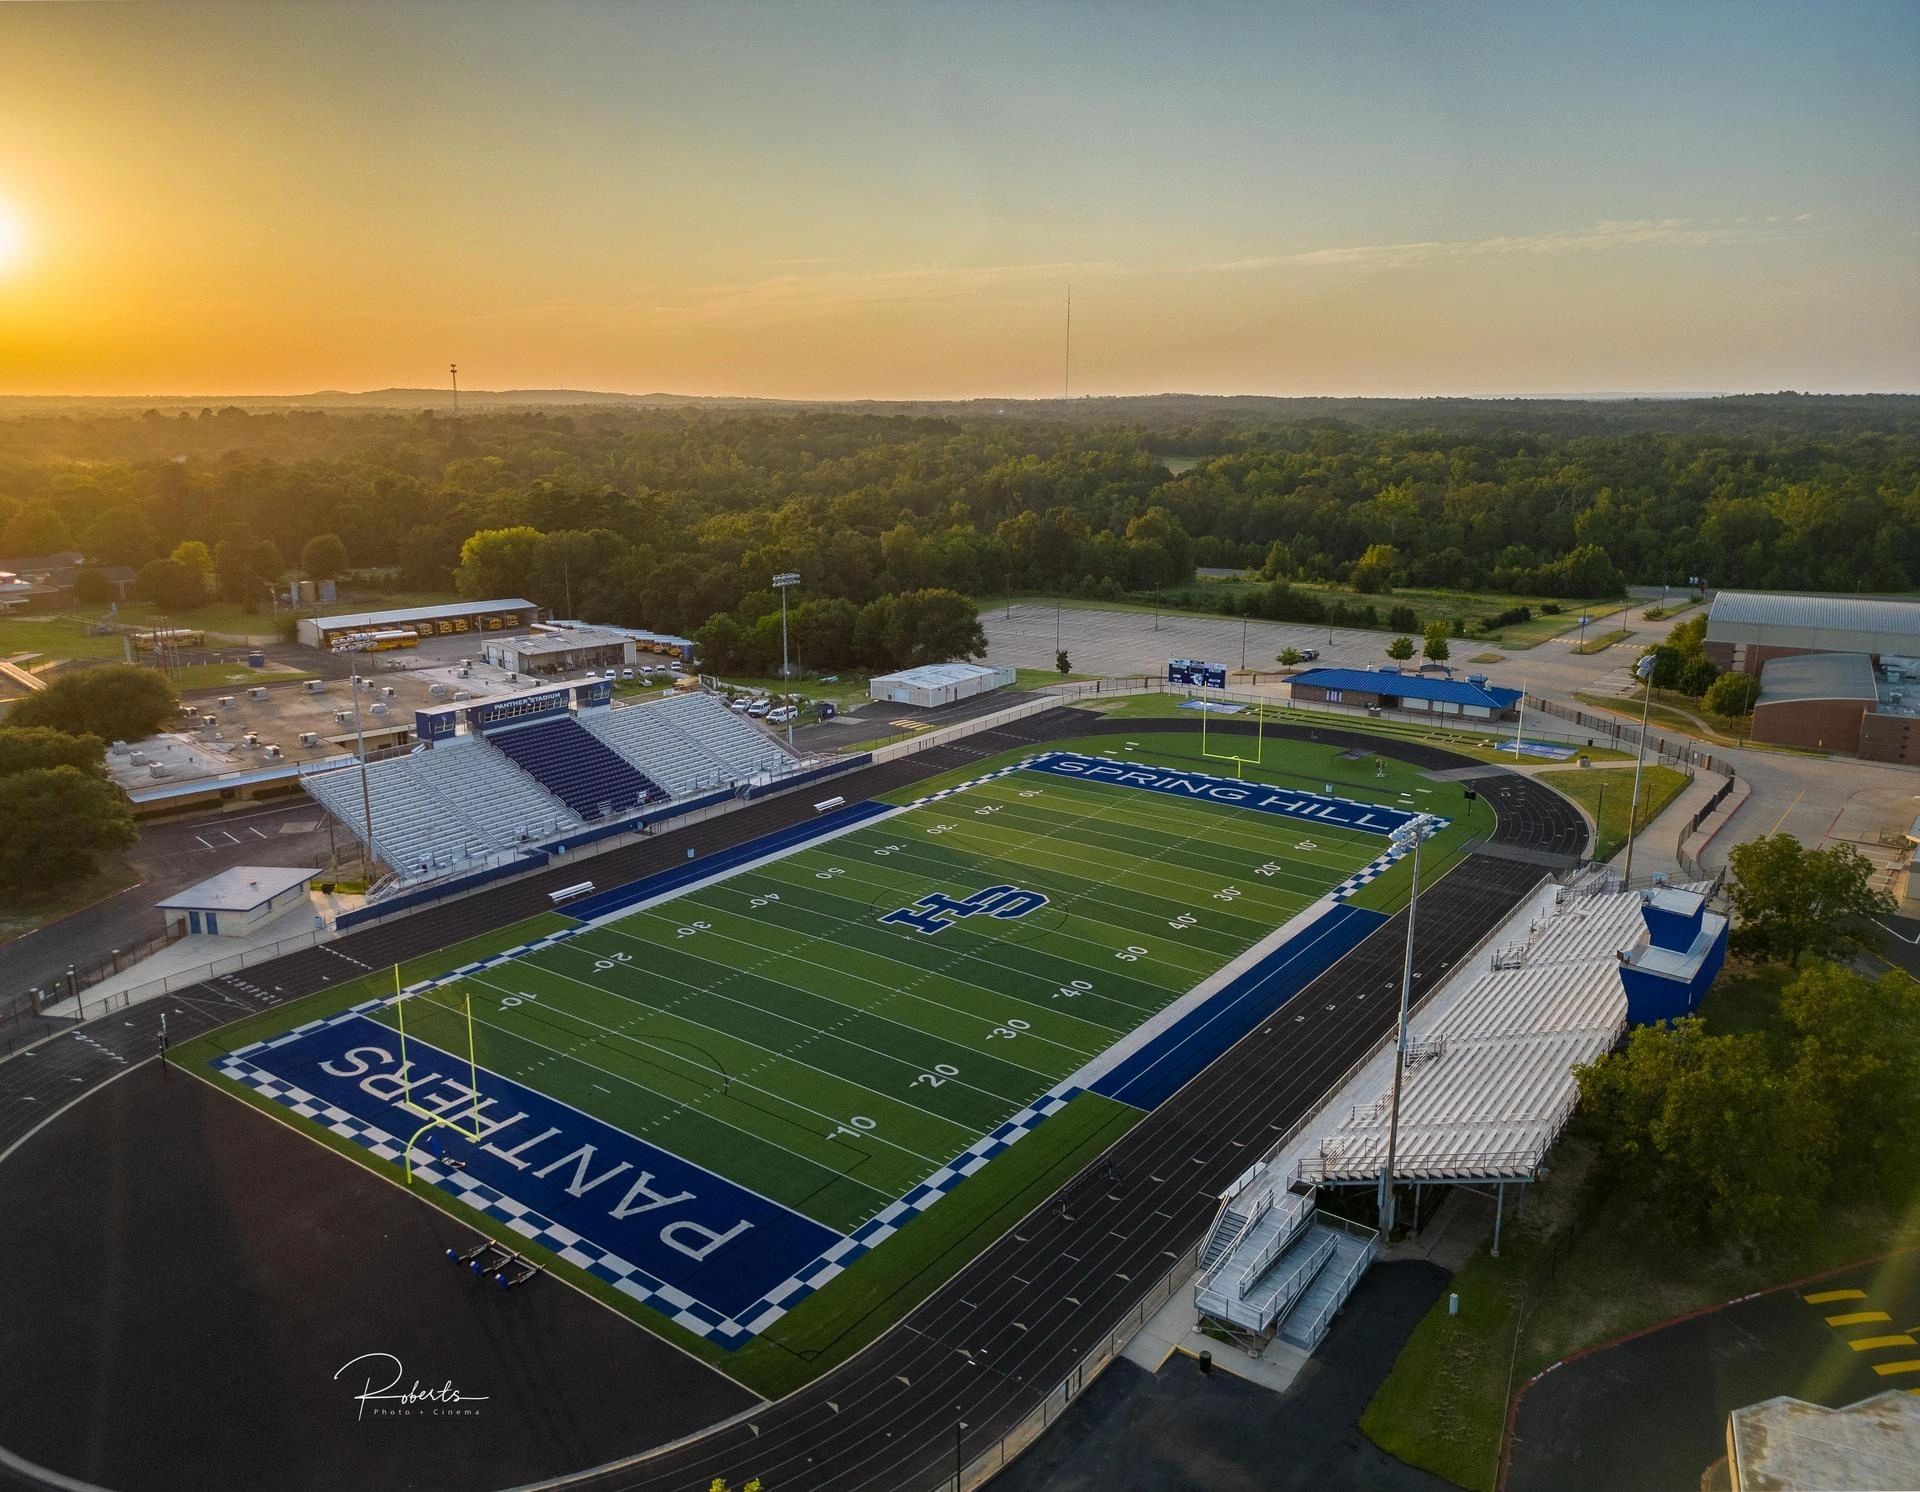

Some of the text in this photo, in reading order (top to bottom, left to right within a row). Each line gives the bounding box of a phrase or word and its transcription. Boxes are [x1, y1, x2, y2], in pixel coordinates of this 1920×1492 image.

[494, 692, 561, 710] PANTHER STADIUM
[1052, 760, 1390, 830] SPRING HILL
[873, 845, 900, 856] 40
[815, 867, 846, 880] 50
[1254, 864, 1281, 877] 20
[750, 893, 780, 906] 40
[1213, 888, 1242, 901] 30
[677, 920, 712, 935] 30
[1168, 915, 1198, 930] 40
[594, 952, 633, 969] 20
[1114, 946, 1149, 962] 50
[1059, 980, 1093, 998] 40
[501, 991, 538, 1006] 10
[992, 1019, 1031, 1039] 30
[918, 1064, 960, 1088] 20
[837, 1116, 877, 1138] 10
[318, 1045, 756, 1262] PANTHERS
